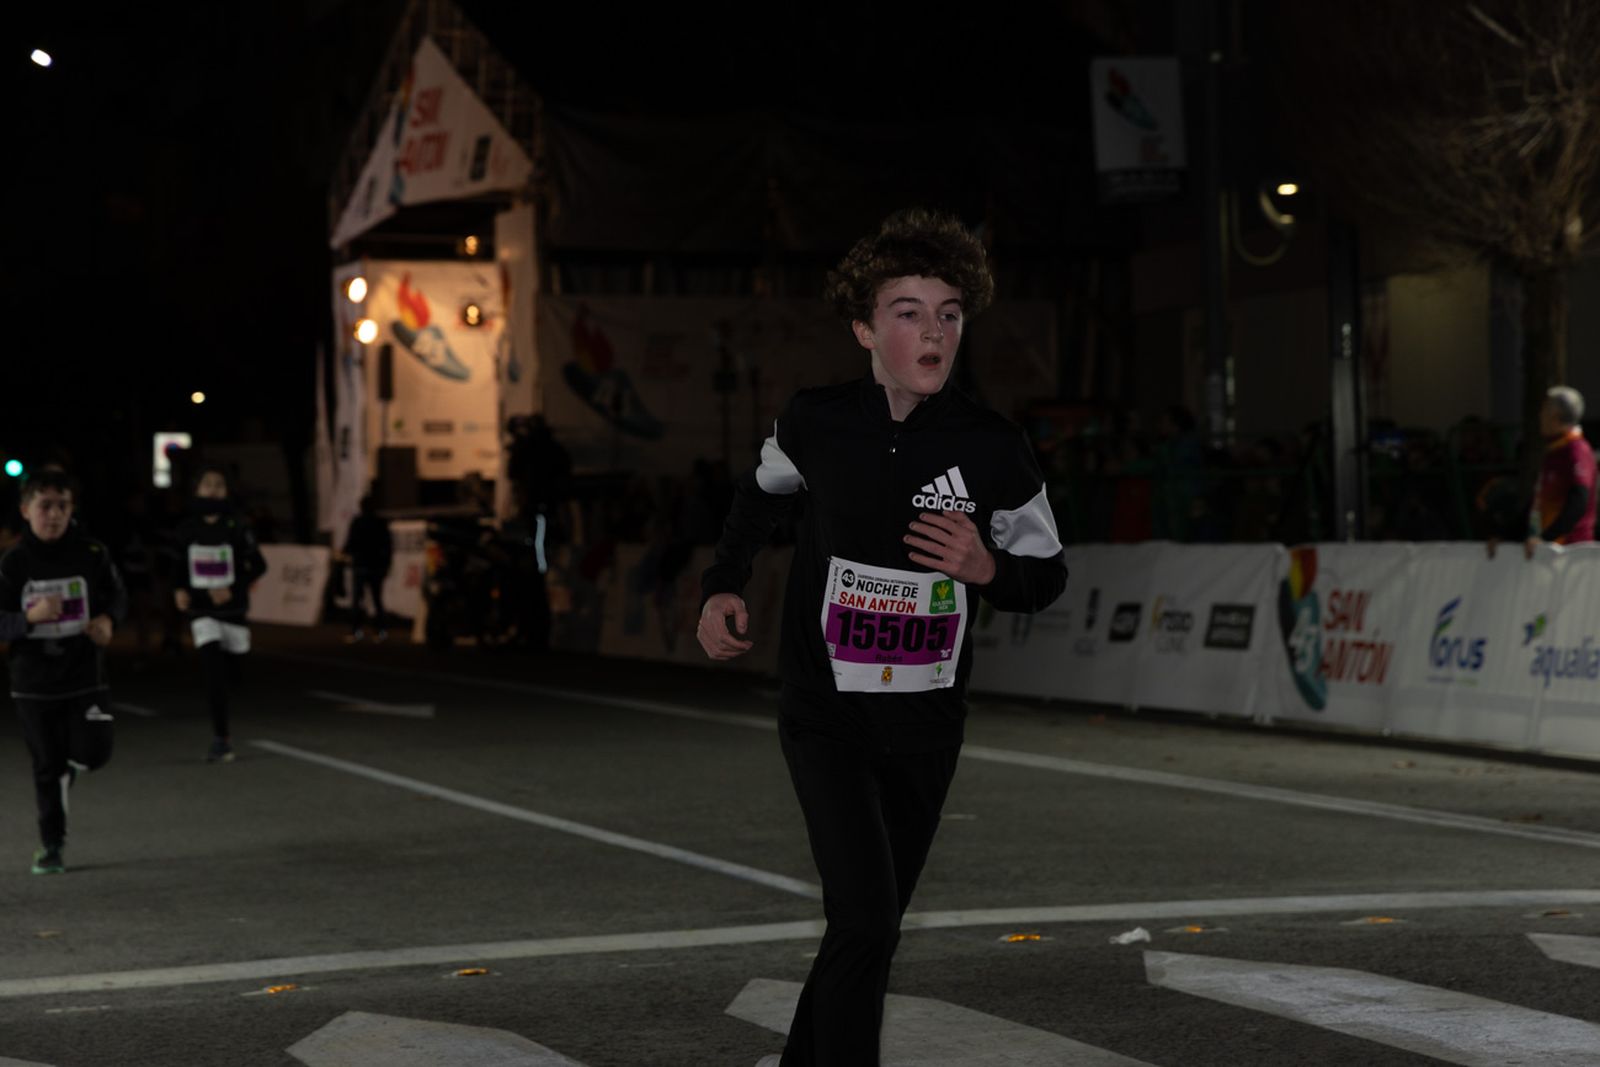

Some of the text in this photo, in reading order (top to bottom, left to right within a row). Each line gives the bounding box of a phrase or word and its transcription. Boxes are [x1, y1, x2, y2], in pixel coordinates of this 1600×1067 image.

[911, 493, 976, 513] adidas
[839, 591, 866, 609] SAN
[868, 597, 917, 614] ANTÓN
[856, 579, 919, 598] NOCHE DE
[836, 610, 948, 652] 15505
[1325, 590, 1370, 633] SAN
[1316, 630, 1391, 684] ANTÓN
[1530, 637, 1600, 688] aqualia
